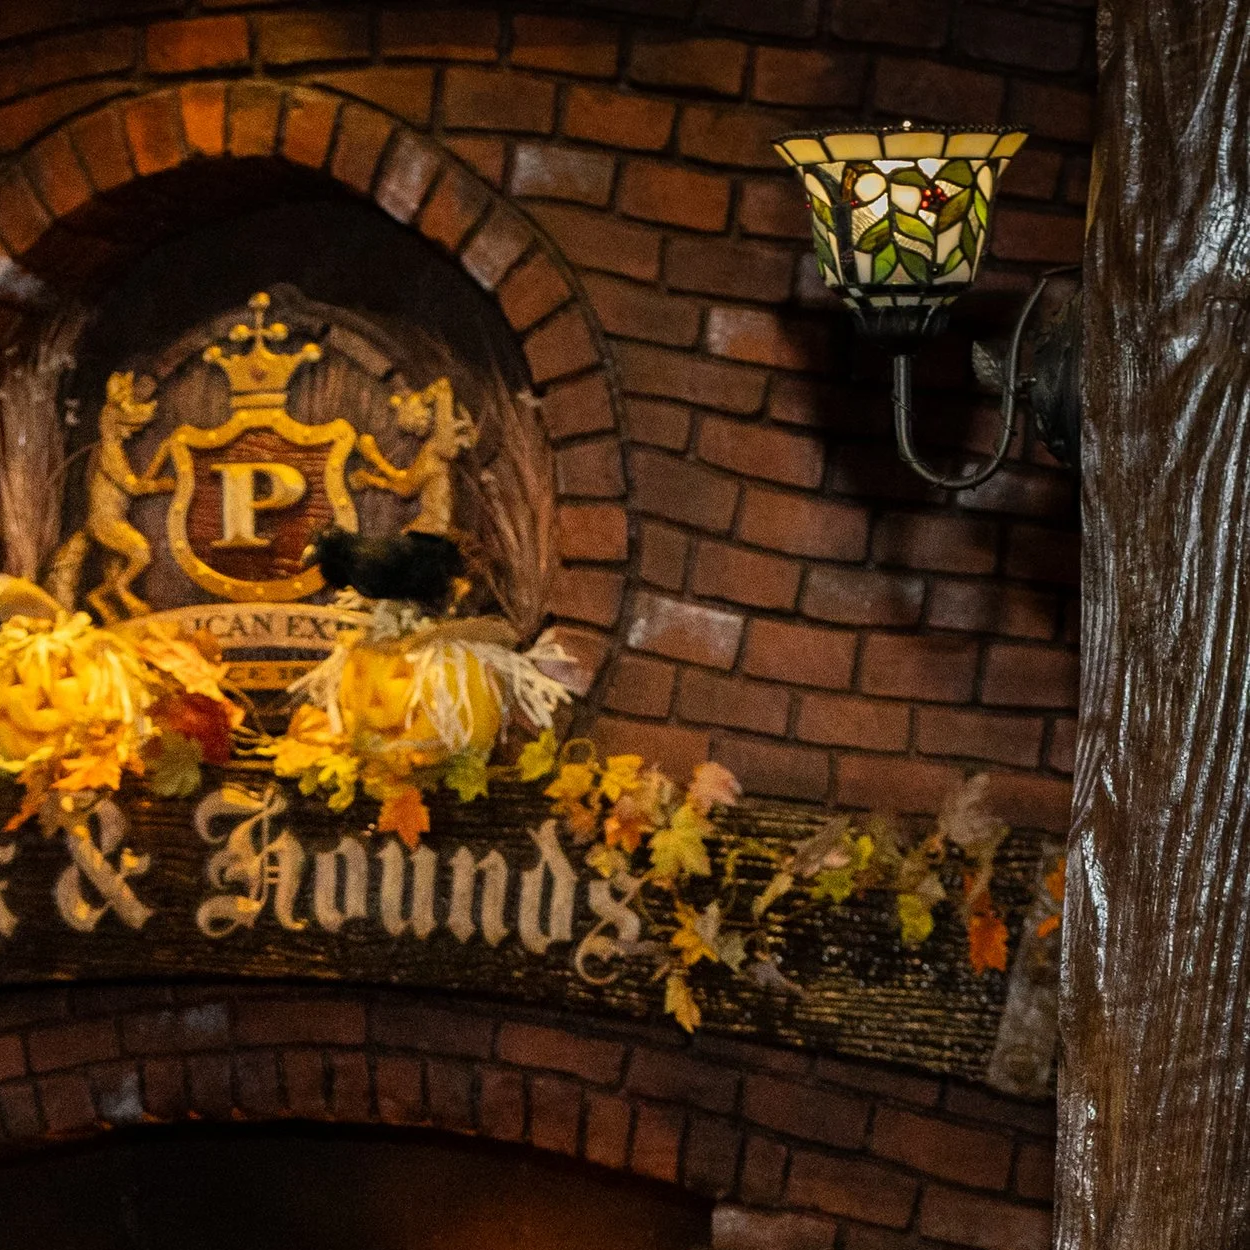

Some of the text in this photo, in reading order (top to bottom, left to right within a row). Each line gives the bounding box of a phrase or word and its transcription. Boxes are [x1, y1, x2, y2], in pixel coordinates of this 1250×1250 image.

[210, 462, 306, 547] P
[54, 796, 152, 932] &
[195, 783, 646, 985] Hounds
